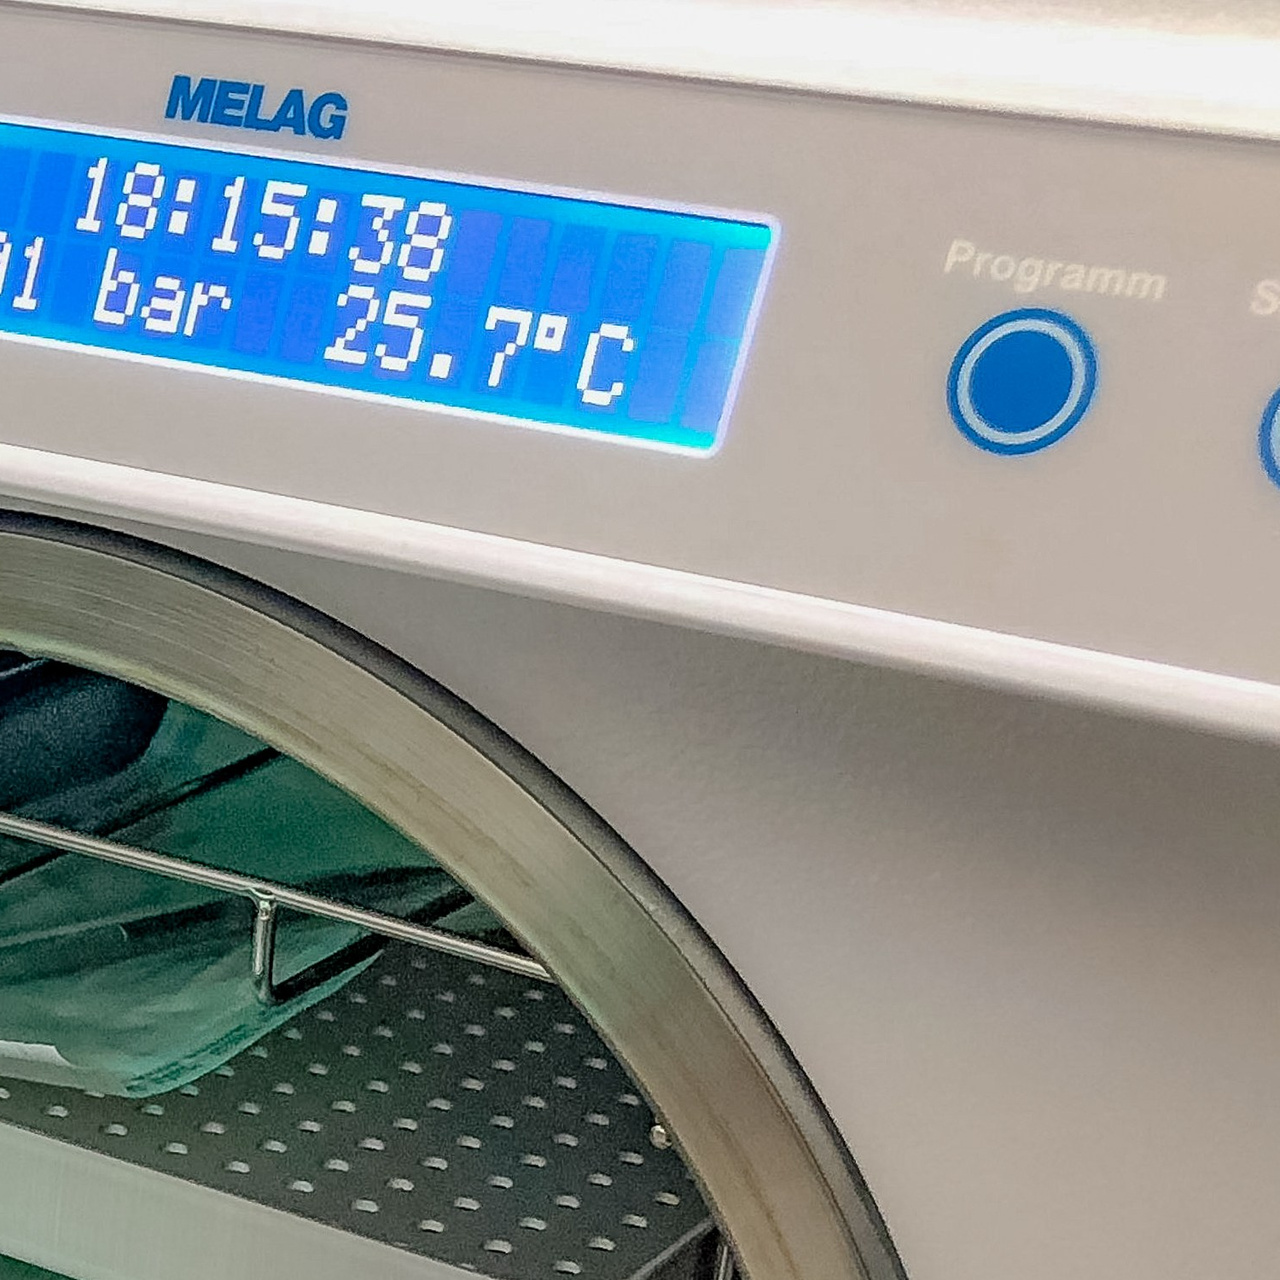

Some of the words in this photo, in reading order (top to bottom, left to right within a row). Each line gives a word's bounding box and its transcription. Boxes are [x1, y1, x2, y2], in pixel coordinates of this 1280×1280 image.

[164, 74, 348, 140] MELAG
[74, 156, 451, 280] 18:15:38
[92, 247, 231, 338] bar
[944, 239, 1169, 300] Programm
